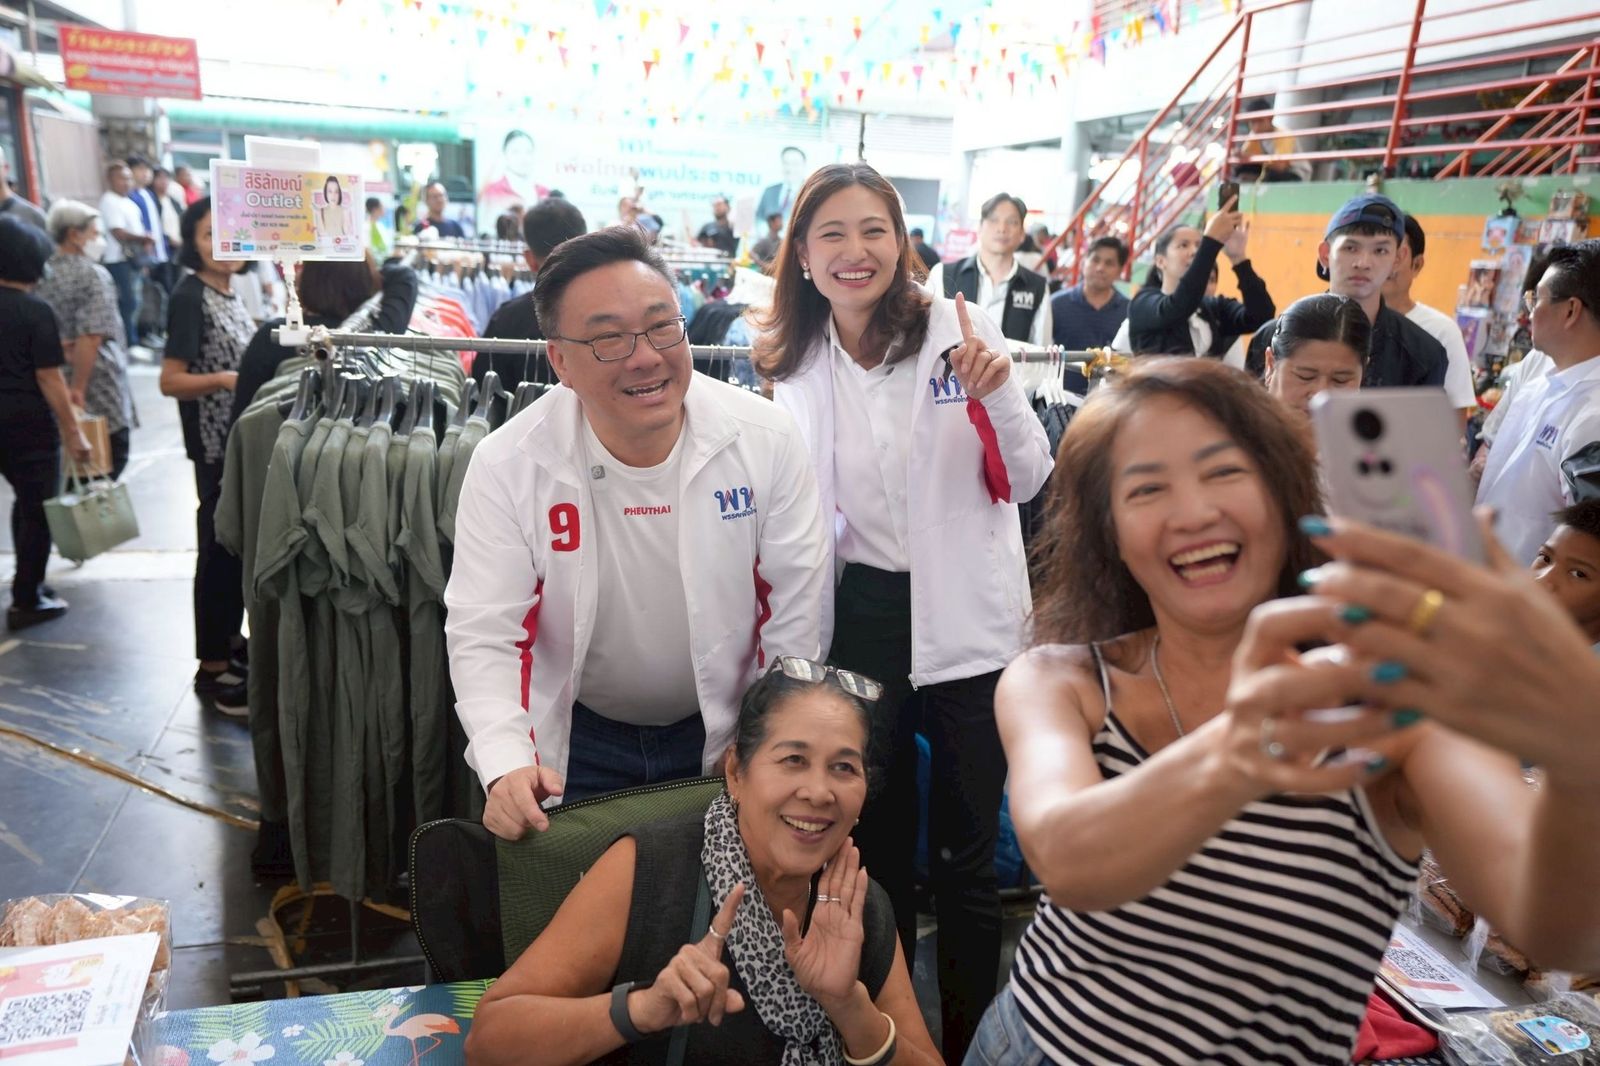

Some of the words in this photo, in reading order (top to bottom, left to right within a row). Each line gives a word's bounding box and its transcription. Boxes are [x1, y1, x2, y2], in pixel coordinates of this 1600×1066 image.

[245, 172, 303, 192] สิริลักษณ์
[246, 192, 304, 209] Outlet
[623, 504, 672, 516] PHEUTHAI
[548, 502, 581, 552] 9
